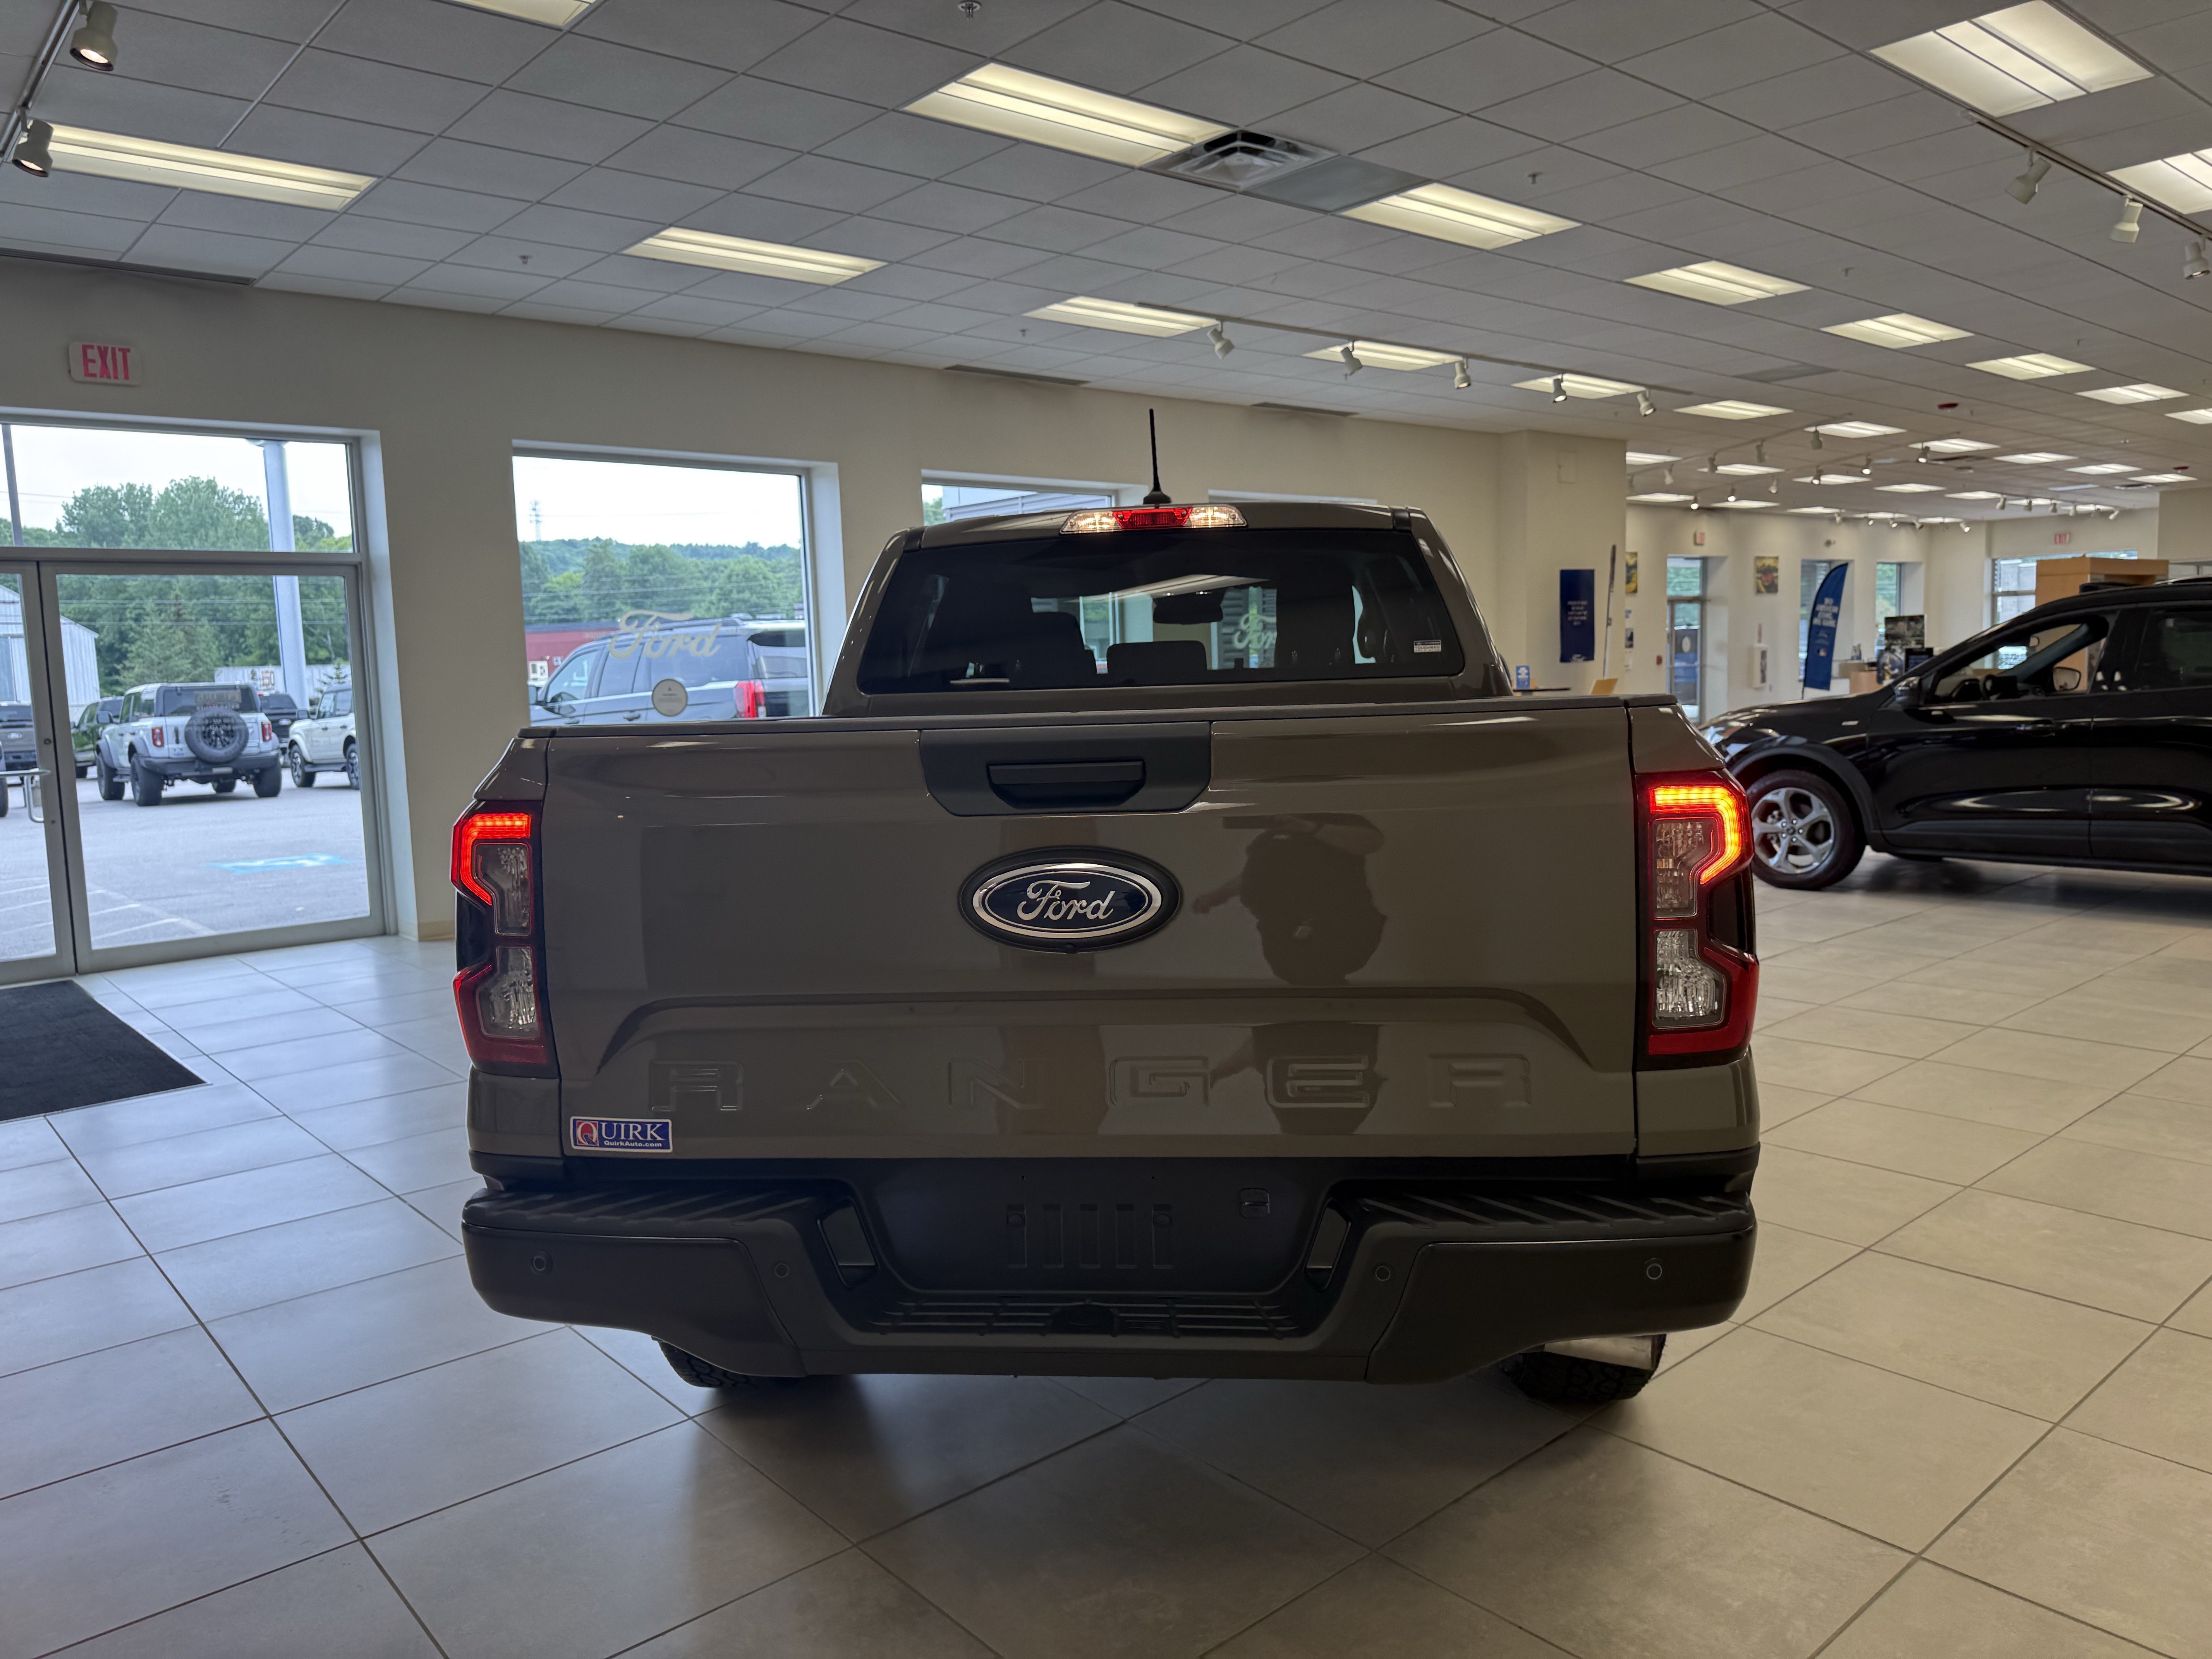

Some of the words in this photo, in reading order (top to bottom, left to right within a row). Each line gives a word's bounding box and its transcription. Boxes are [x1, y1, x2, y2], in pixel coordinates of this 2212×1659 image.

[82, 344, 131, 381] EXIT
[608, 609, 723, 659] Ford
[1233, 613, 1277, 649] For
[1017, 880, 1116, 921] Ford
[650, 1053, 1532, 1111] RANGER
[577, 1121, 665, 1146] QUIRK
